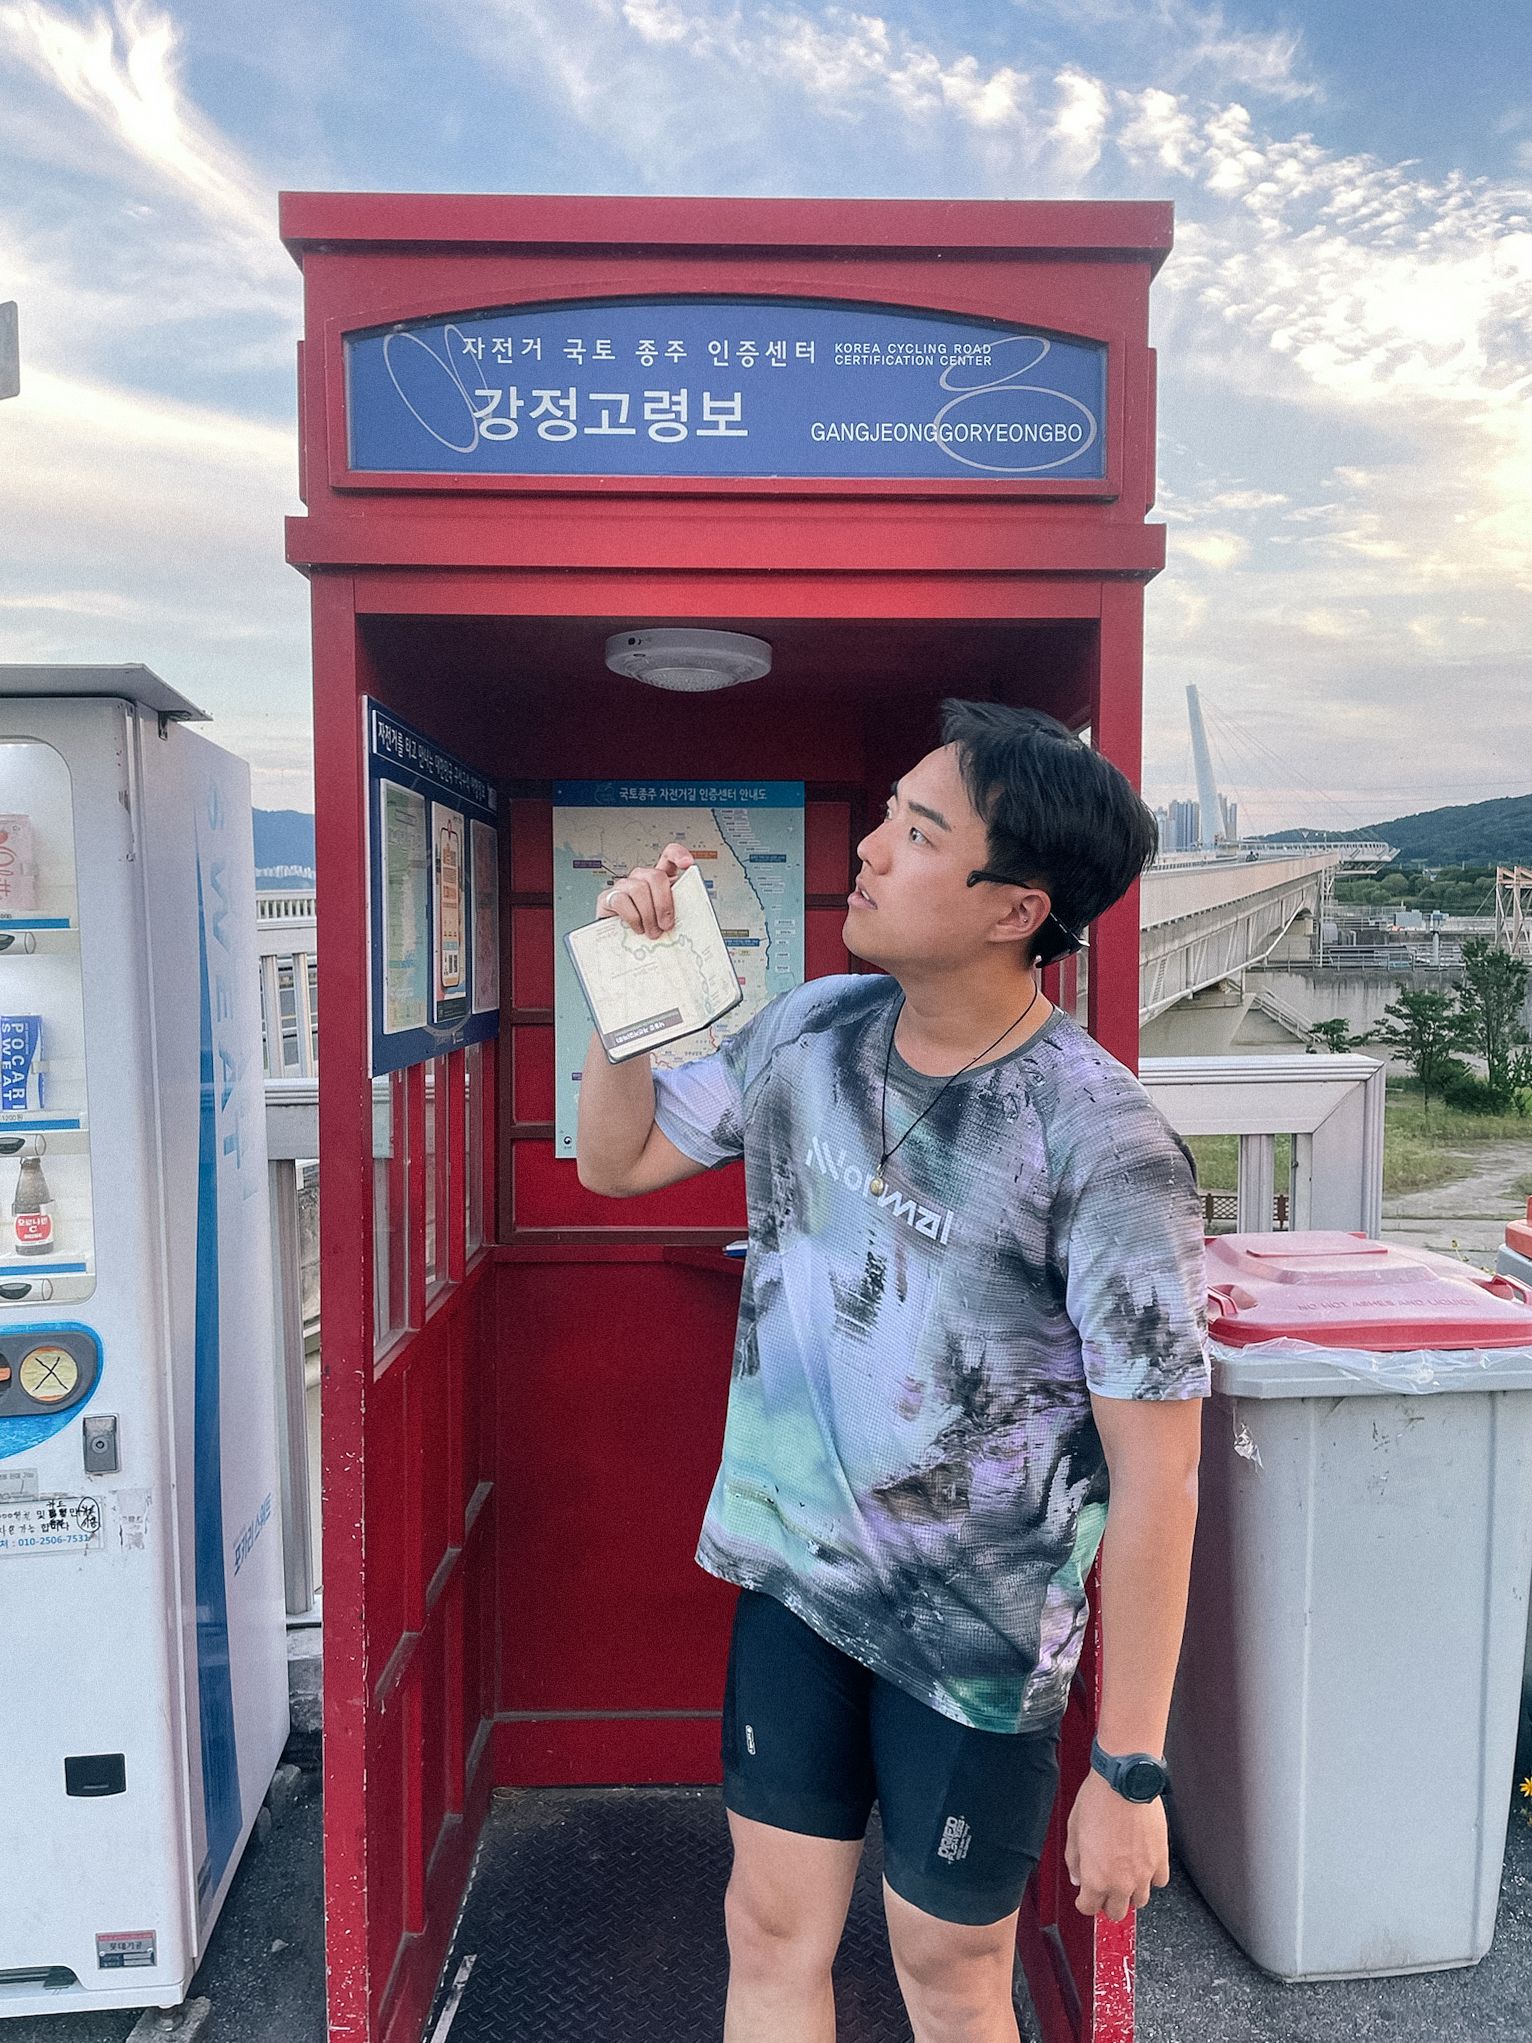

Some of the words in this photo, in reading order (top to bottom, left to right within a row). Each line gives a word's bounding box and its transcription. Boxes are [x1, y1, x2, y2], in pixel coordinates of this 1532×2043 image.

[462, 337, 542, 364] 자전거
[563, 338, 616, 365] 국토
[635, 339, 687, 367] 종주
[708, 339, 815, 368] 인증센터
[834, 343, 881, 354] KOREA
[887, 343, 947, 354] CYCLING
[953, 343, 992, 354] ROAD
[834, 355, 934, 366] CERTIFICATION
[939, 355, 992, 366] CENTER
[473, 386, 749, 443] 강정고령보
[810, 422, 1083, 443] GANGJEONGGORYEONGBO
[378, 721, 404, 758] 자전거를
[405, 736, 418, 759] 타고
[619, 787, 657, 800] 국토종주
[659, 787, 697, 801] 자전거길
[699, 787, 737, 801] 인증센터
[739, 787, 768, 801] 안내도
[2, 1023, 13, 1101] SWEAT
[11, 1022, 26, 1109] POCARI
[29, 1225, 38, 1233] C
[1297, 1303, 1317, 1311] NO
[18, 1533, 89, 1547] 010-2506-7531
